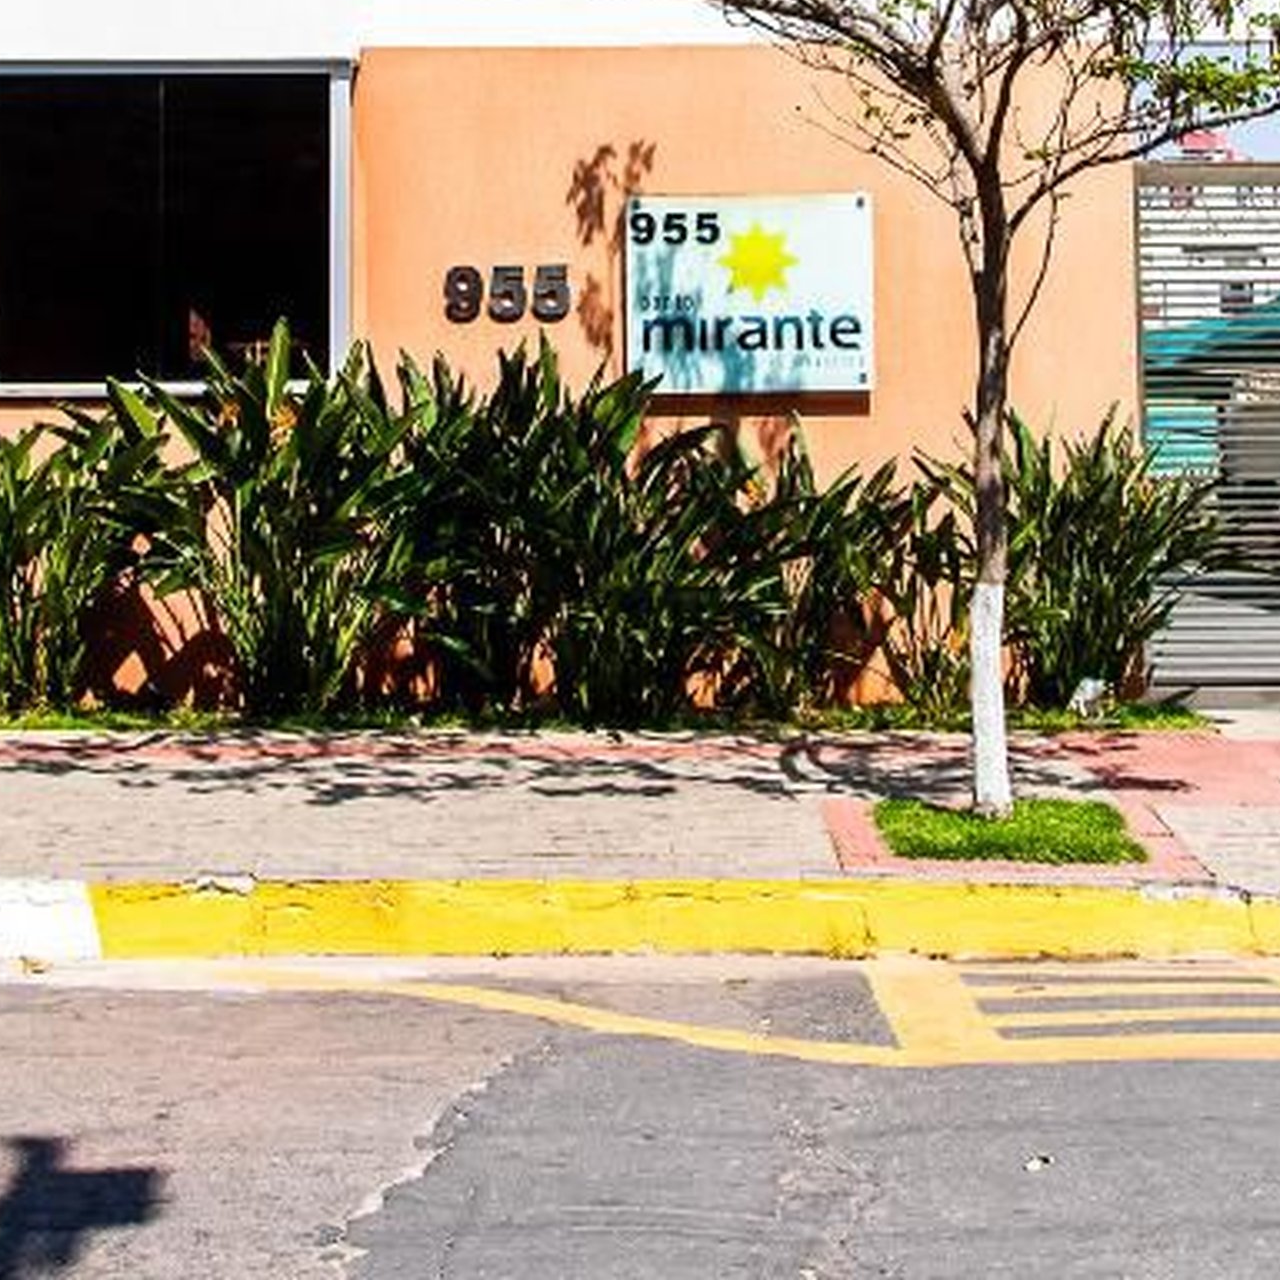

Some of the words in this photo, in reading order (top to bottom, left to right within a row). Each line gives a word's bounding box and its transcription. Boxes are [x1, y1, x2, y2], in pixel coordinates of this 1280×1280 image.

[630, 211, 721, 246] 955
[443, 264, 571, 324] 955
[642, 308, 862, 352] mirante
